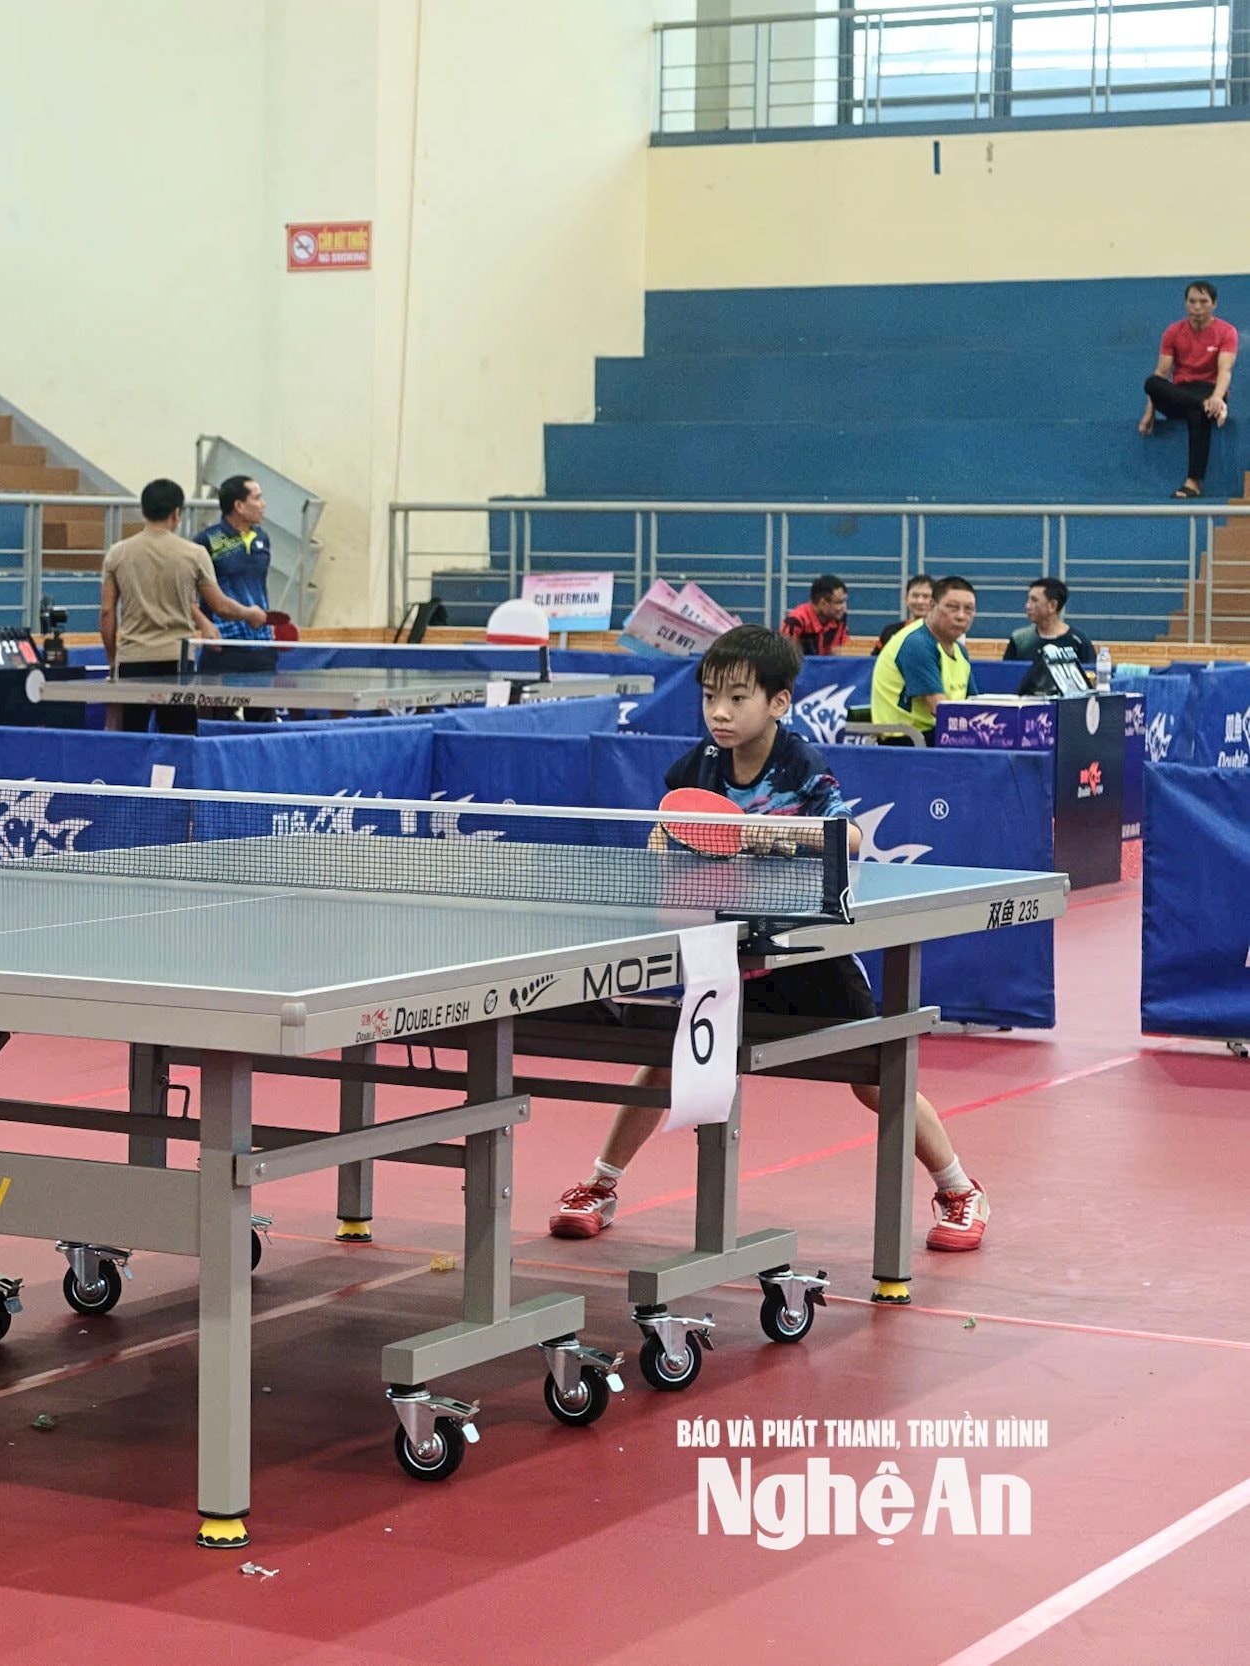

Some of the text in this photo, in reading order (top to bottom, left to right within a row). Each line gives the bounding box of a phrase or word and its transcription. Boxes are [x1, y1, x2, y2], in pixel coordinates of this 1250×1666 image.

[1018, 899, 1039, 922] 235
[393, 1000, 471, 1036] DOUBLE FISH
[690, 989, 718, 1066] 6
